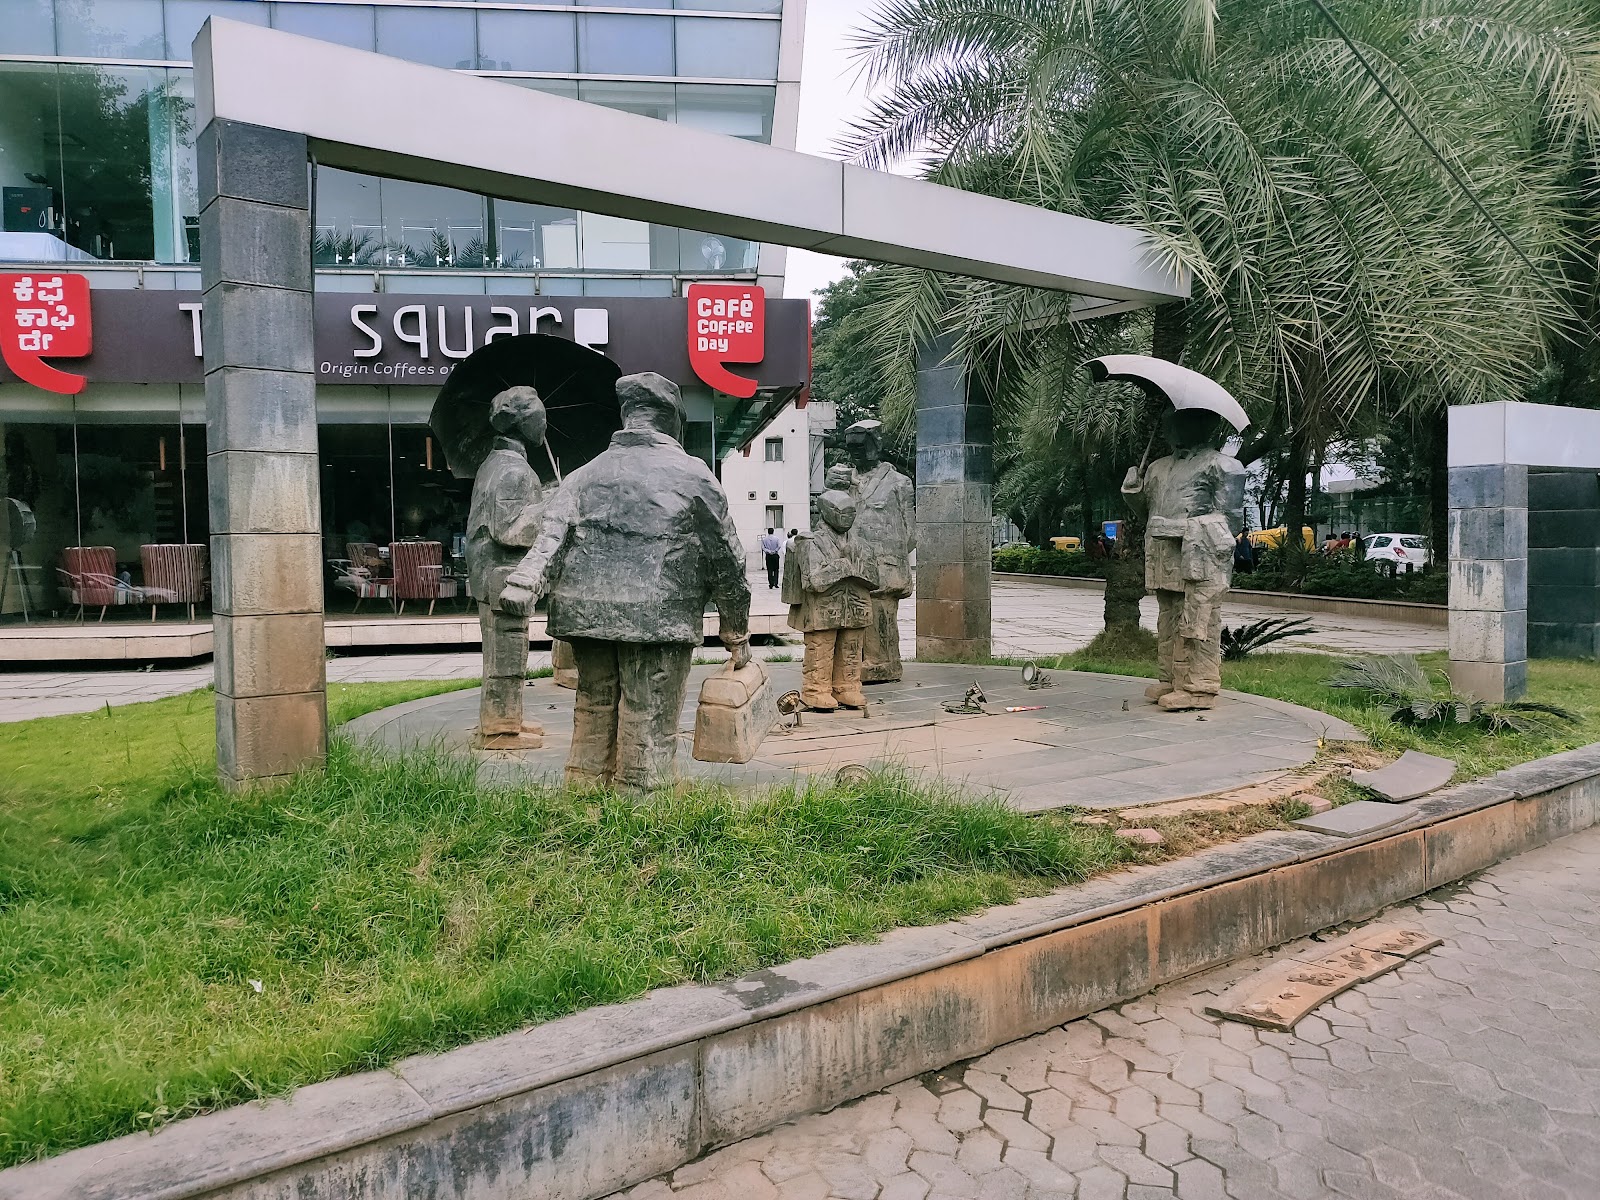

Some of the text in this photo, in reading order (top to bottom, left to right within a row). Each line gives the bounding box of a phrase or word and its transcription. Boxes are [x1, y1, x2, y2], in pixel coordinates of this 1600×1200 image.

[697, 293, 753, 318] Café
[15, 305, 75, 331] ಕಾಫಿ
[697, 319, 754, 335] Coffee
[697, 337, 729, 353] Day
[320, 361, 369, 378] Origin
[373, 362, 435, 378] Coffees
